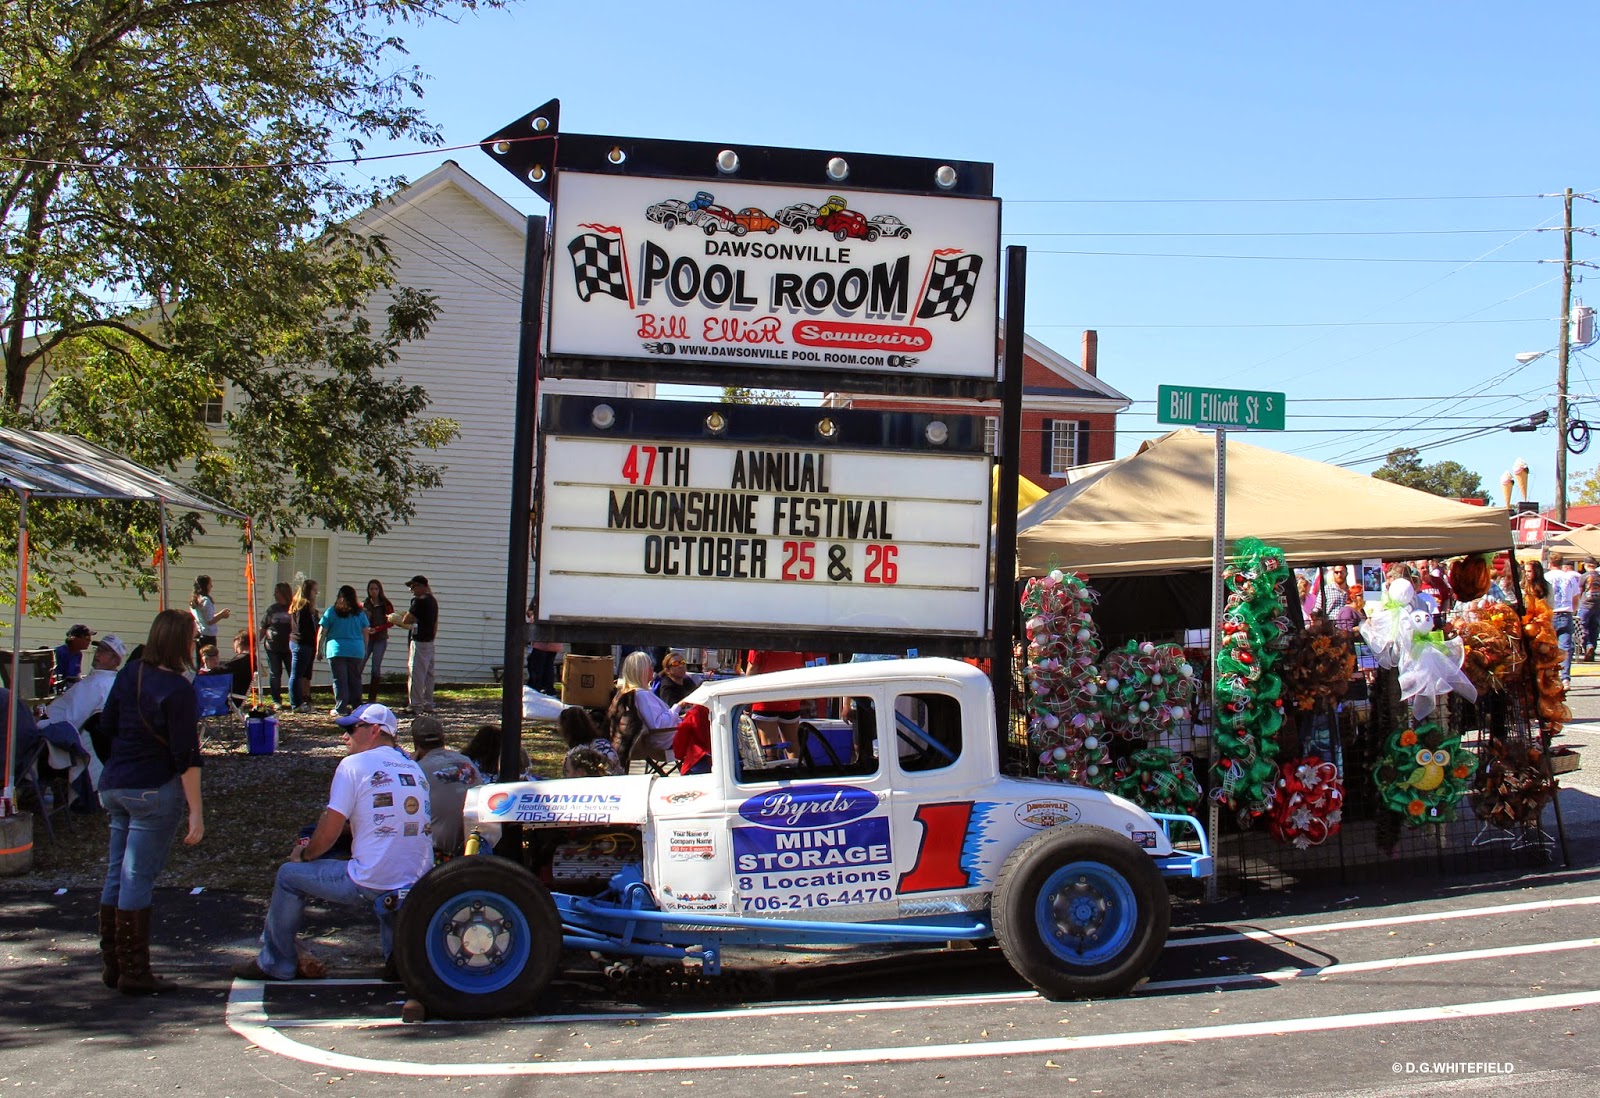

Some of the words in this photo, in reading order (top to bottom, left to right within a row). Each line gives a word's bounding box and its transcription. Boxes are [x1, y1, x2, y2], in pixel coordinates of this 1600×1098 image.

[705, 240, 851, 263] DAWSONVILLE
[640, 239, 758, 310] POOL
[774, 255, 910, 316] ROOM
[635, 313, 690, 339] Bill
[703, 316, 784, 344] Elliott
[800, 325, 925, 346] Souvenirs
[680, 345, 788, 359] WWW.DAWSONVILLE
[792, 351, 820, 361] POOL
[824, 353, 884, 366] ROOM.COM
[1170, 391, 1192, 420] Bill
[1201, 393, 1238, 423] Elliott
[1246, 396, 1259, 424] St
[1266, 397, 1273, 411] S
[622, 445, 689, 487] 47TH
[731, 450, 829, 493] ANNUAL
[607, 489, 758, 534] MOONSHINE
[773, 497, 893, 540] FESTIVAL
[644, 535, 767, 578] OCTOBER
[782, 541, 815, 581] 25
[827, 544, 853, 582] &
[864, 544, 898, 584] 26
[520, 794, 622, 803] SIMMONS
[761, 790, 856, 825] Byrds
[1027, 803, 1068, 812] DAWSONVILLE
[515, 812, 611, 823] 706-974-8021
[776, 829, 846, 850] MINI
[896, 800, 975, 895] 1
[739, 844, 888, 871] STORAGE
[739, 877, 753, 890] 8
[763, 870, 891, 889] Locations
[741, 887, 892, 910] 706-216-4470
